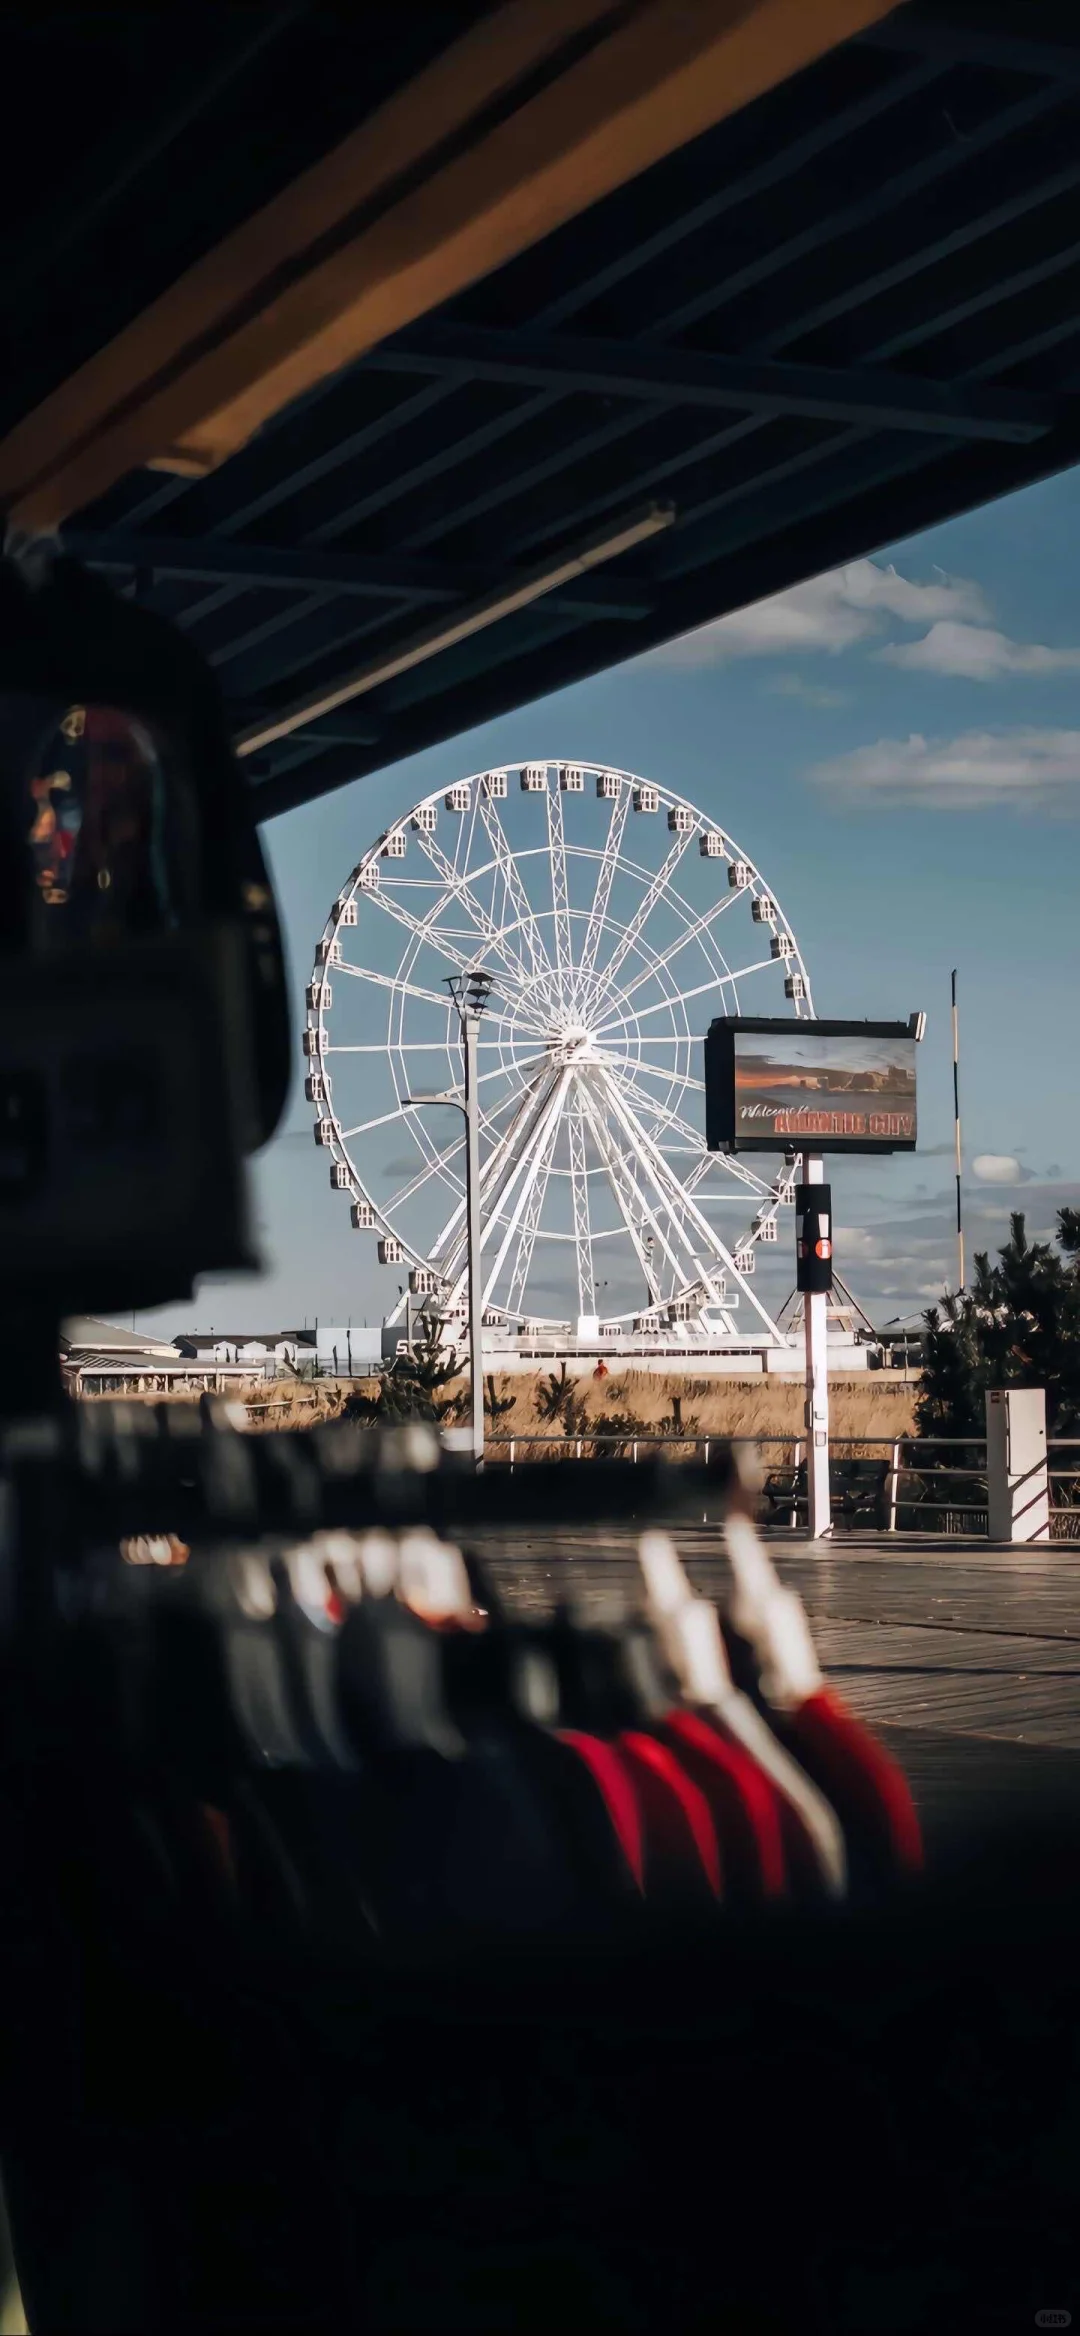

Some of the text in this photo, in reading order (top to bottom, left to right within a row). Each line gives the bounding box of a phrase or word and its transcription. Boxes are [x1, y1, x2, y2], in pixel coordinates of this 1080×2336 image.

[739, 1103, 797, 1119] Welcome
[774, 1111, 913, 1136] ATLANTIC CITY
